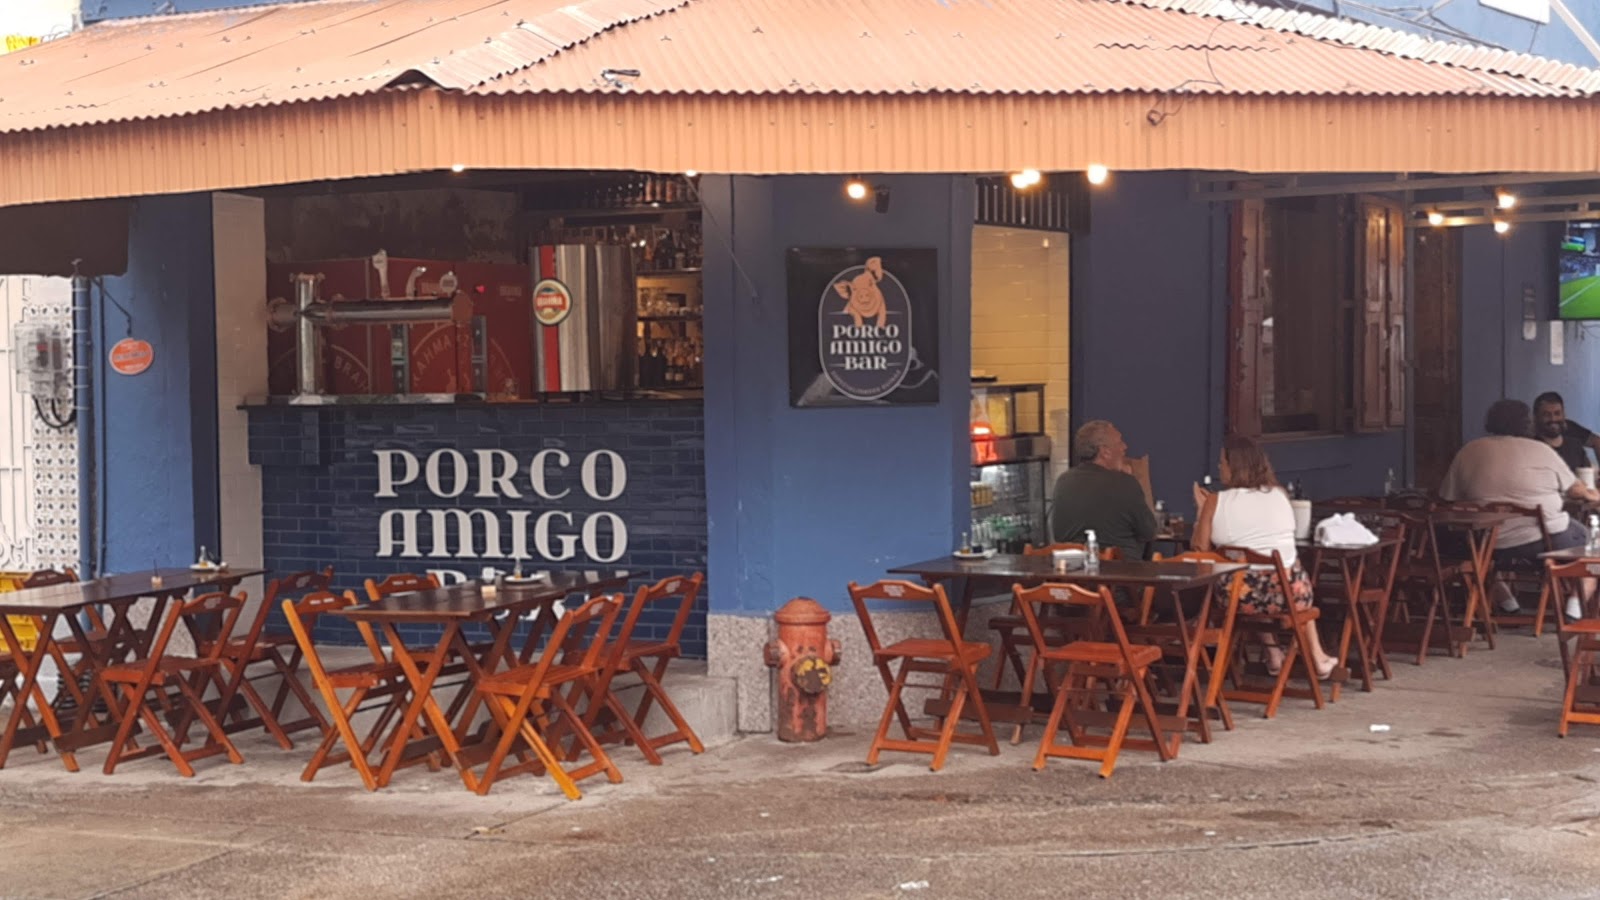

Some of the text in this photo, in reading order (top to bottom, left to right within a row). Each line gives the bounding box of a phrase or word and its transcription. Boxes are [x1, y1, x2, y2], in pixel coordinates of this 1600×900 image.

[832, 324, 899, 339] PORCO
[830, 340, 902, 355] AMIGO
[844, 356, 887, 371] BAR
[372, 448, 628, 501] PORCO
[376, 508, 629, 563] AMIGO
